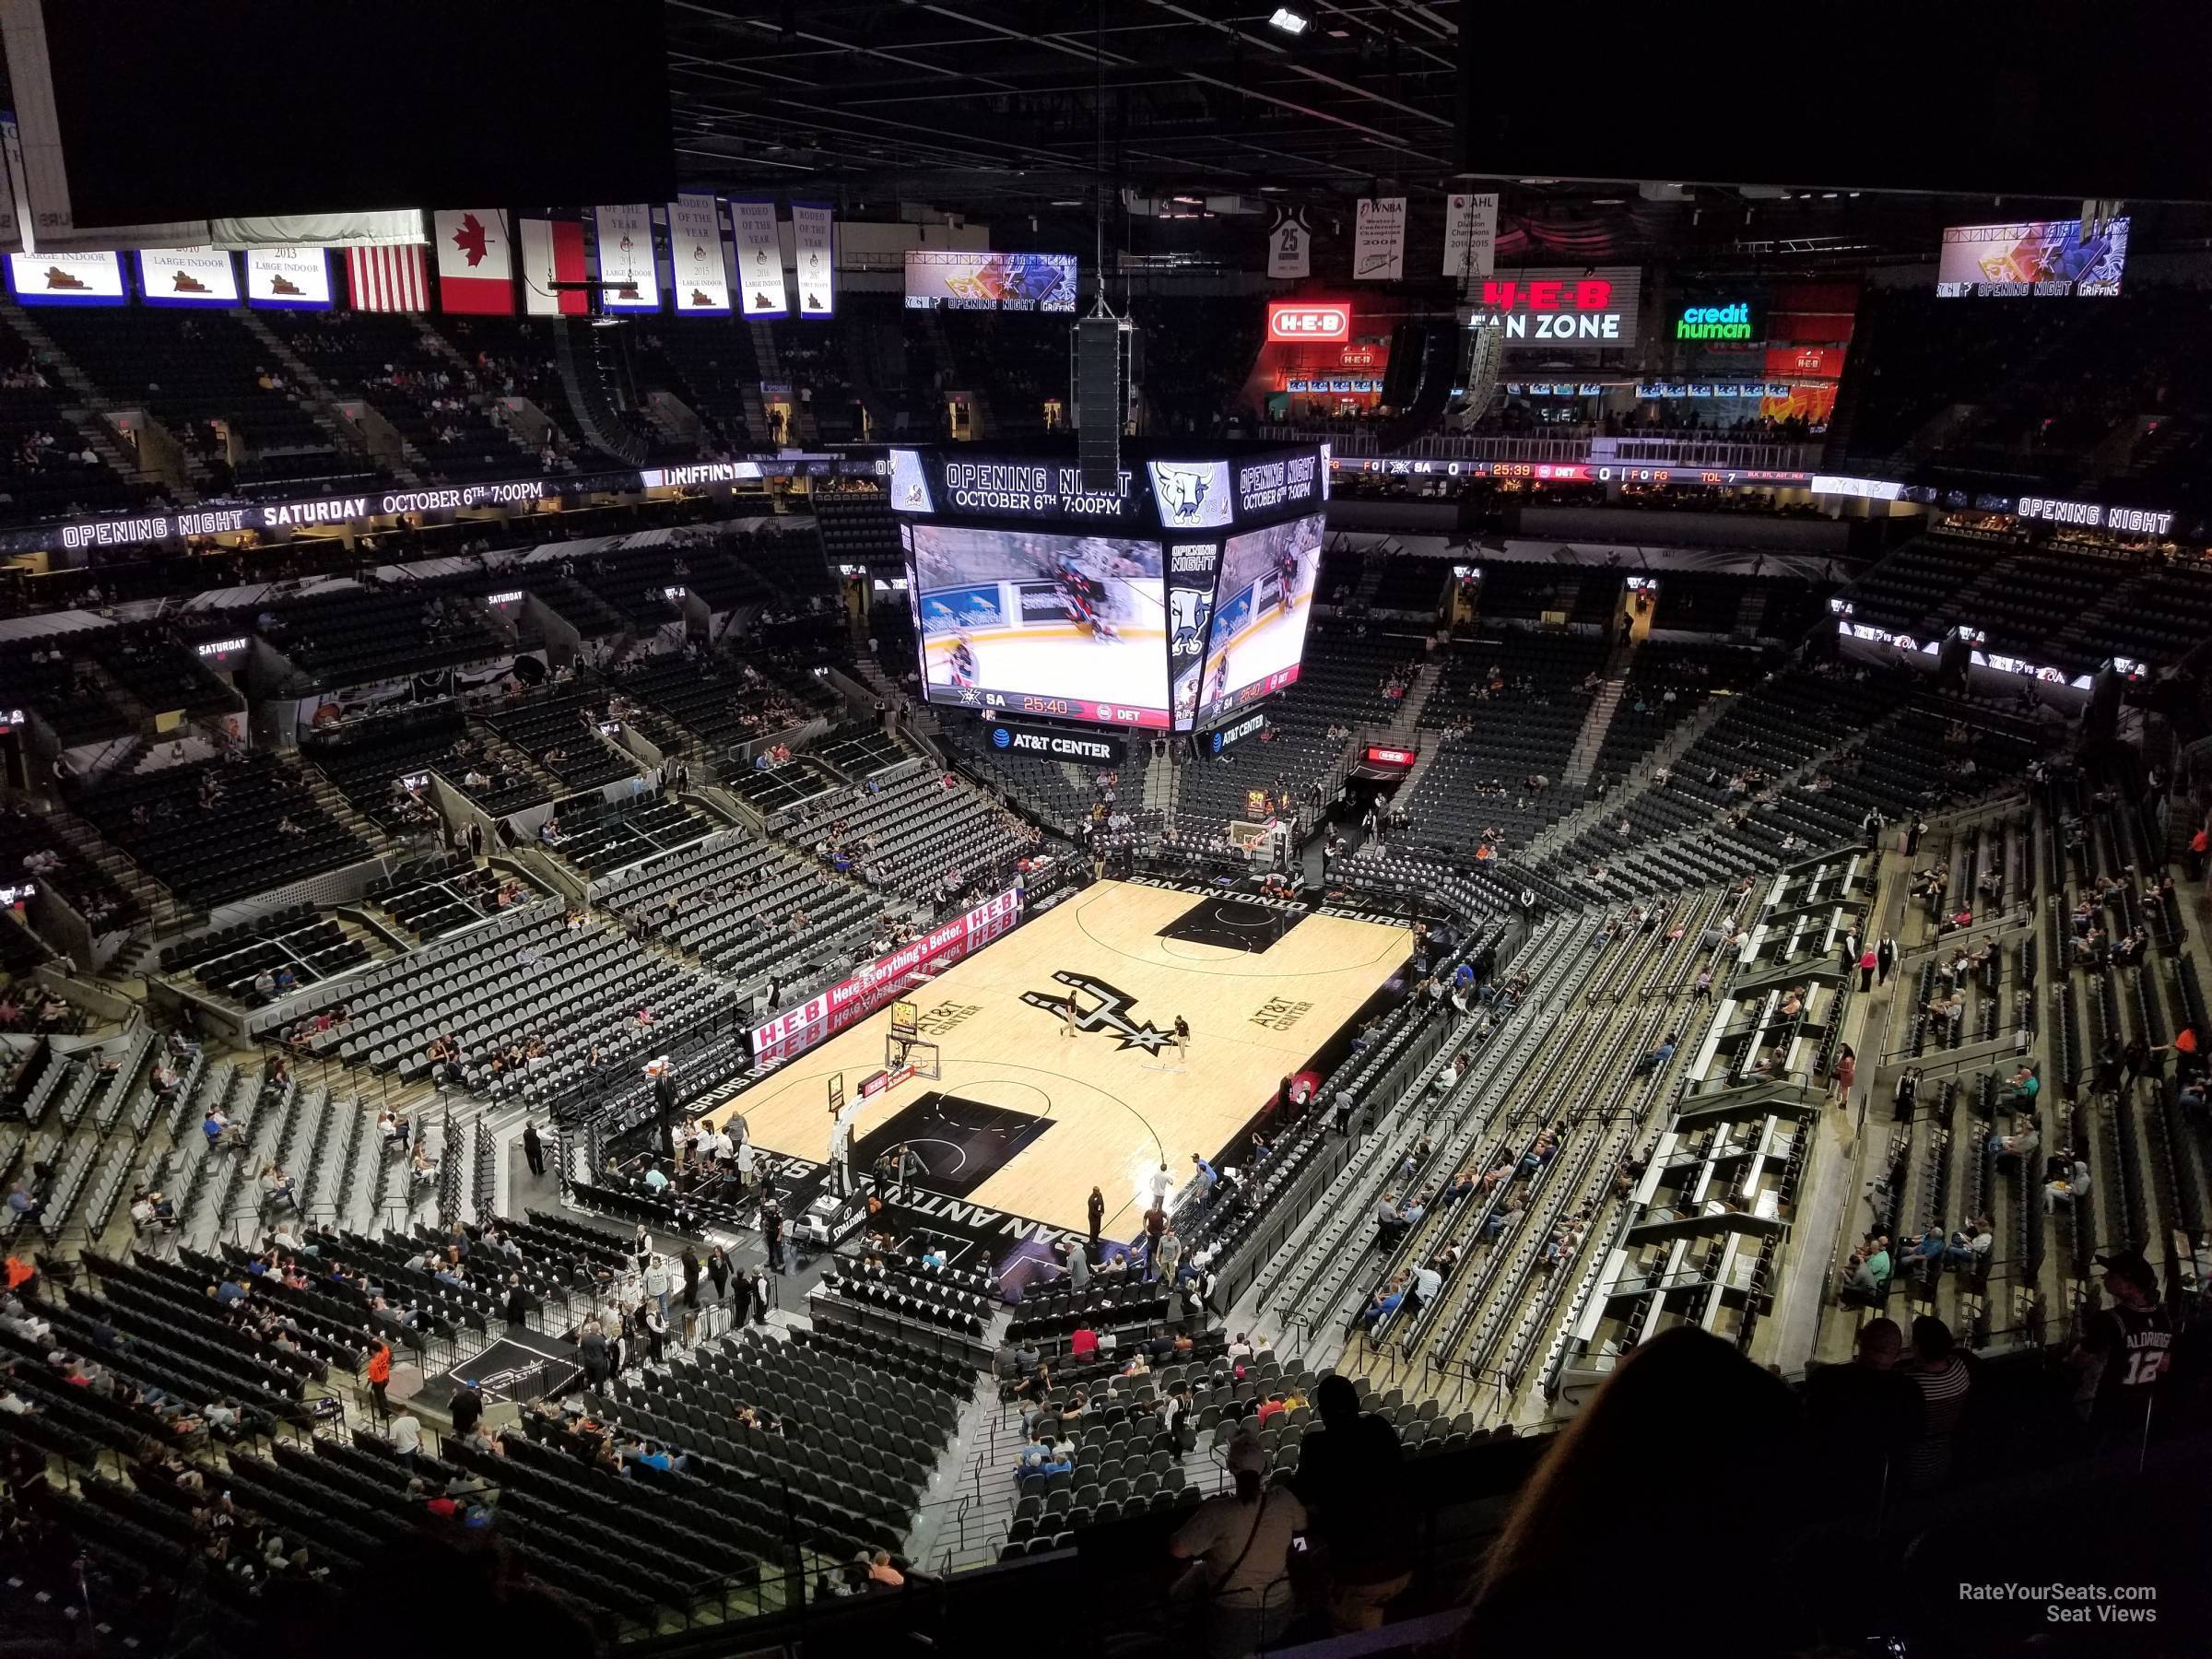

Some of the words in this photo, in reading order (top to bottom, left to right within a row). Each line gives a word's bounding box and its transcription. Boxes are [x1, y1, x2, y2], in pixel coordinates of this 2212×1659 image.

[1371, 204, 1402, 213] WNBA
[1471, 197, 1492, 207] AHL
[611, 220, 637, 229] YEAR
[677, 213, 690, 221] OF
[692, 214, 712, 223] THE
[799, 211, 824, 220] RODEO
[686, 229, 710, 238] YEAR
[1281, 229, 1299, 252] 25
[62, 253, 105, 261] INDOOR
[154, 257, 185, 265] LARGE
[187, 258, 224, 267] INDOOR
[255, 261, 280, 271] LARGE
[284, 264, 319, 272] INDOOR
[1978, 282, 2028, 297] OPENING
[2034, 281, 2072, 296] NIGHT
[947, 298, 997, 310] OPENING
[1002, 299, 1035, 311] NIGHT
[1684, 303, 1748, 324] credit
[1535, 314, 1620, 338] ZONE
[1677, 320, 1751, 339] human
[1240, 462, 1284, 493] OPENING
[1288, 456, 1315, 485] NIGHT
[1448, 463, 1458, 475] 0
[1493, 464, 1531, 476] 25:39
[1598, 467, 1610, 480] 0
[1653, 471, 1668, 480] FG
[1701, 472, 1721, 482] TOL
[1728, 473, 1735, 482] 7
[947, 464, 1047, 492] OPENING
[1059, 468, 1132, 497] NIT
[264, 498, 367, 525] SATURDAY
[382, 490, 462, 513] OCTOBER
[463, 487, 486, 505] 6TH
[491, 482, 544, 503] 7:00PM
[956, 490, 1031, 511] OCTOBER
[1033, 494, 1057, 510] 6TH
[1062, 496, 1122, 514] 7:00PM
[1243, 489, 1277, 511] OCTOBER
[2018, 498, 2100, 525] OPENING
[2108, 508, 2171, 534] NIGHT
[62, 517, 168, 547] OPENING
[178, 510, 242, 535] NIGHT
[1171, 544, 1217, 557] OPENING
[1171, 556, 1217, 572] NIGHT
[488, 591, 523, 606] SATURDAY
[198, 638, 246, 656] SATURDAY
[986, 693, 1006, 707] SA
[1023, 697, 1067, 714] 25:40
[1117, 709, 1141, 722] DET
[1222, 724, 1240, 747] AT&T
[1239, 713, 1264, 737] CENTER
[1014, 734, 1051, 751] AT&T
[1052, 738, 1111, 759] CENTER
[1125, 876, 1183, 890] SAN
[1186, 885, 1309, 912] ANTONIO
[1315, 906, 1412, 930] SPURS
[929, 924, 962, 949] Better.
[929, 1005, 984, 1036] CENTER
[1248, 996, 1295, 1028] AT&T
[1273, 1002, 1315, 1030] CENTER
[684, 1055, 788, 1112] SPURS.COM
[832, 1205, 867, 1242] SPALDING
[2123, 1351, 2164, 1384] 12
